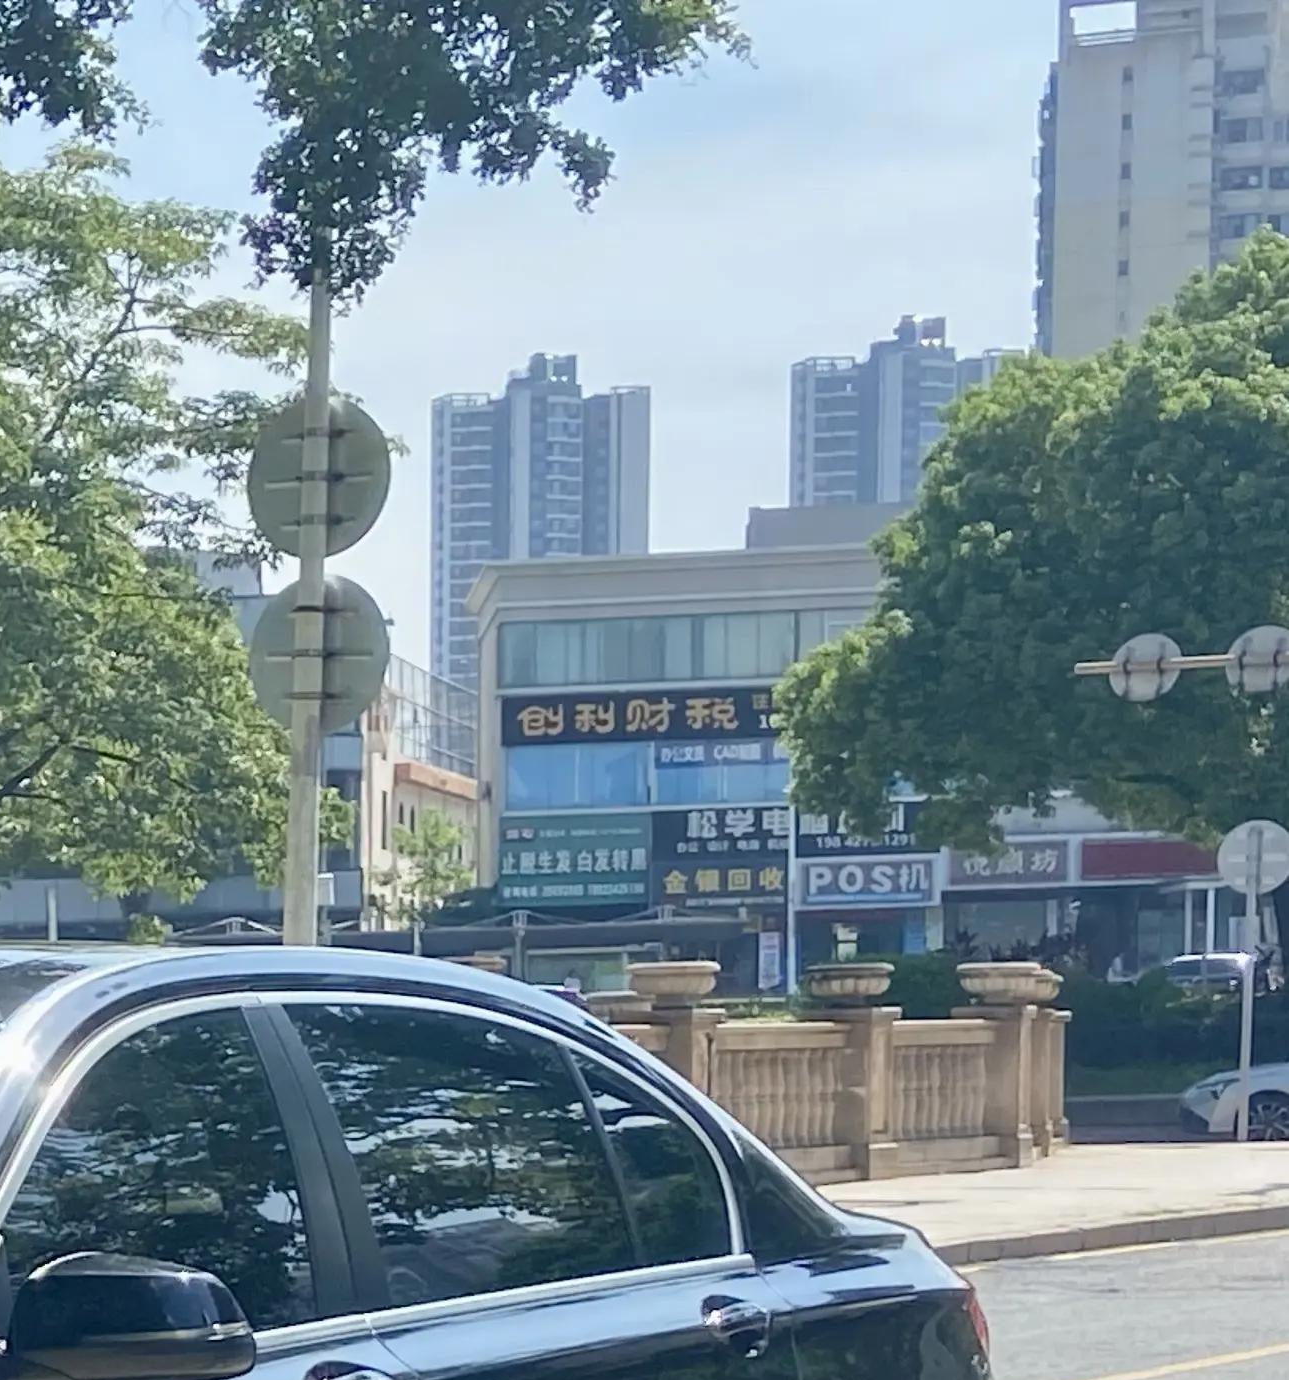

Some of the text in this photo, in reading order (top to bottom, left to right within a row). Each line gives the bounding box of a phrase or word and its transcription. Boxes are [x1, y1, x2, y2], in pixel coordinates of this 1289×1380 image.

[517, 697, 739, 737] 创利财税
[663, 867, 785, 895] 金银回收
[808, 863, 930, 894] POS机
